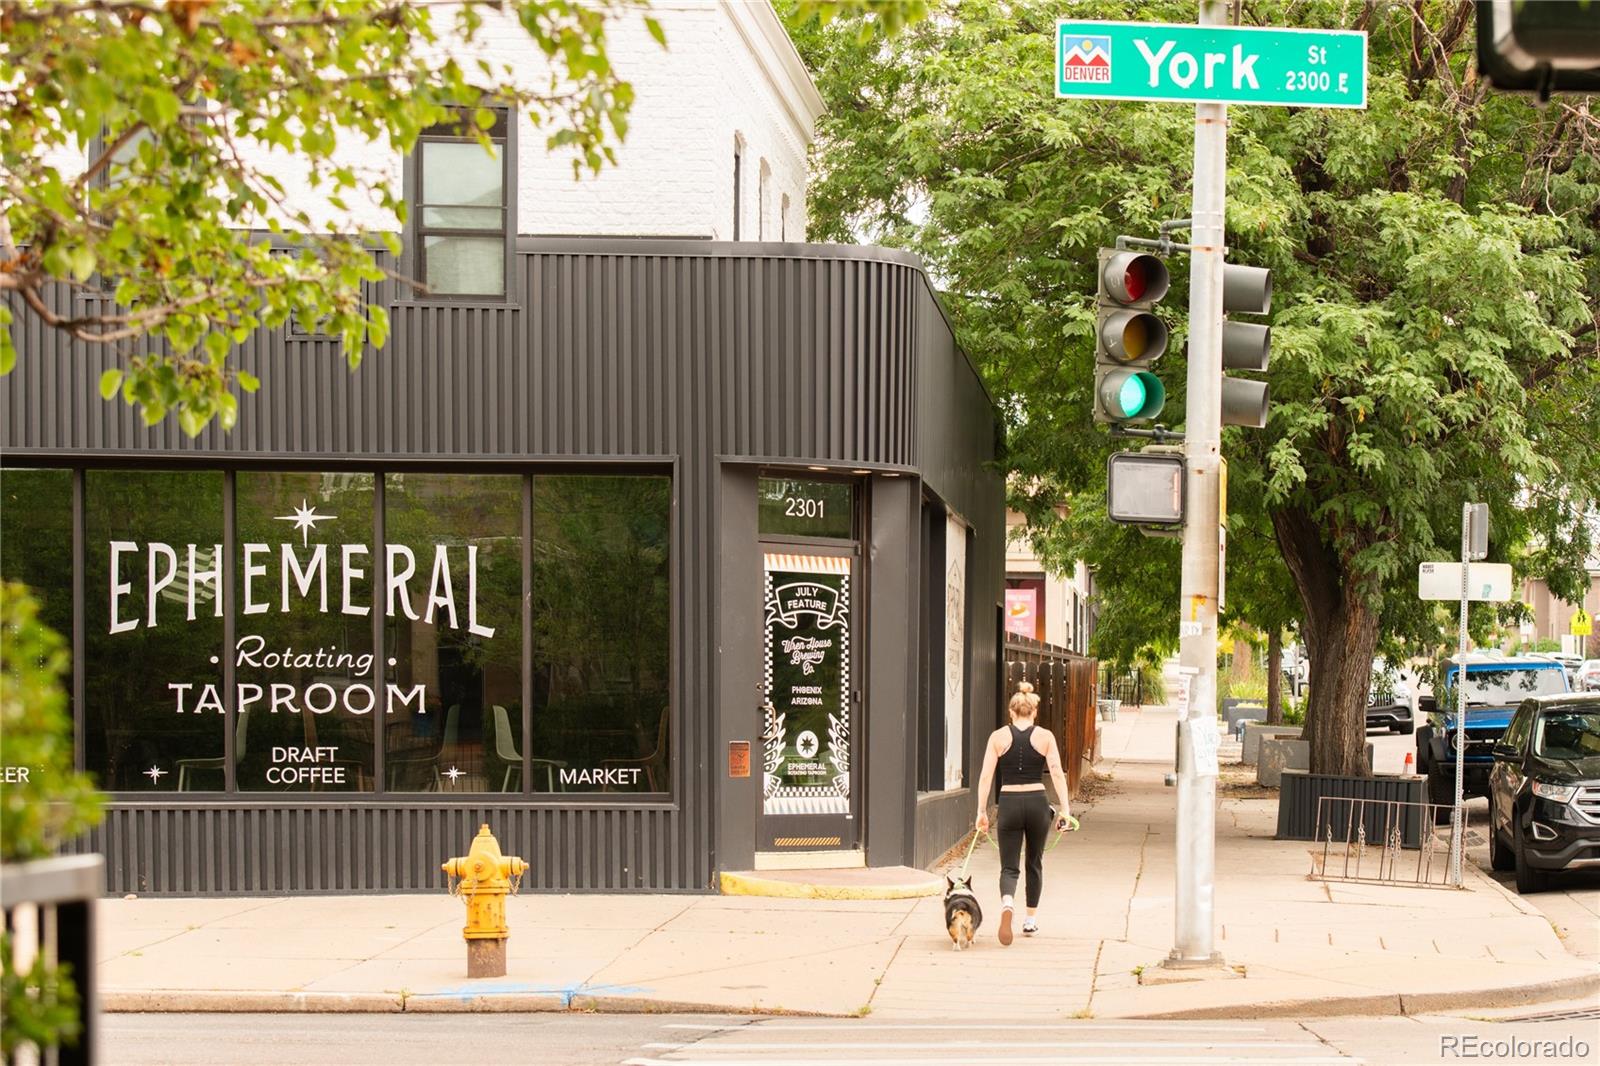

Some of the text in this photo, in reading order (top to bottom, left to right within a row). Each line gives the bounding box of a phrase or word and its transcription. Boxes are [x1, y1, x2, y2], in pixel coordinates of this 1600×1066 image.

[1133, 39, 1260, 90] York
[1307, 45, 1327, 65] St
[1064, 65, 1110, 82] DENVER
[1285, 70, 1349, 94] 2300 E
[785, 497, 824, 519] 2301
[109, 541, 496, 639] EPHEMERAL
[795, 586, 819, 597] JULY
[787, 598, 827, 610] FEATURE
[235, 634, 375, 677] Rotating
[790, 649, 825, 665] Brewing
[168, 682, 427, 715] TAPROOM
[791, 685, 823, 694] PHOENIX
[791, 697, 823, 706] ARIZONA
[271, 745, 339, 764] DRAFT
[265, 766, 346, 785] COFFEE
[787, 762, 827, 770] EPHEMERAL
[559, 767, 641, 785] MARKET
